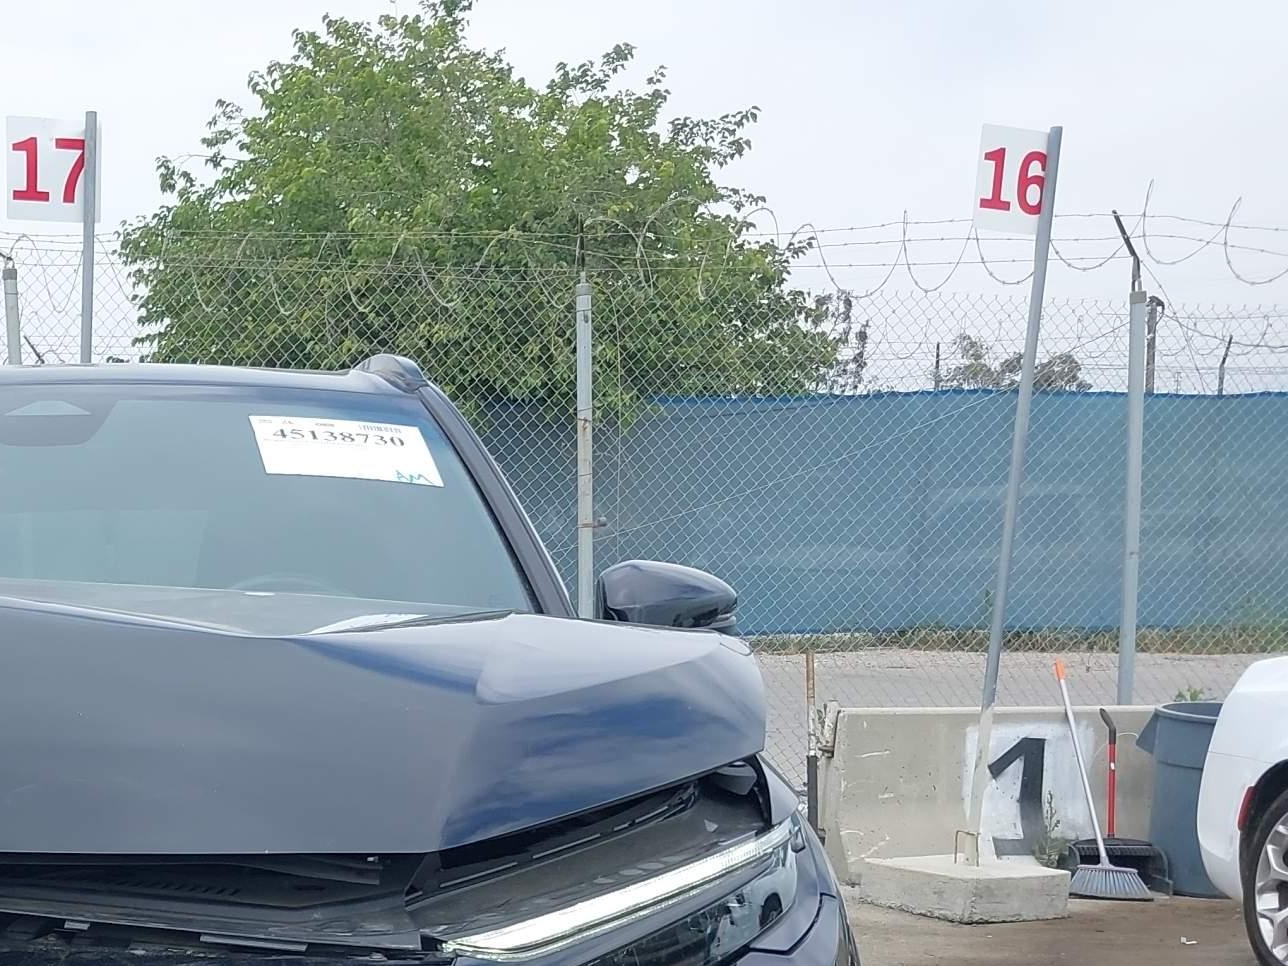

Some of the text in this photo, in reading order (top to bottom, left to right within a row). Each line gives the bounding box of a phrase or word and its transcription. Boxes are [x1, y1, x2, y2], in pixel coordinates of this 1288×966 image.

[12, 137, 86, 204] 17
[979, 147, 1048, 216] 16
[272, 428, 405, 447] 45138730
[987, 737, 1048, 857] 1
